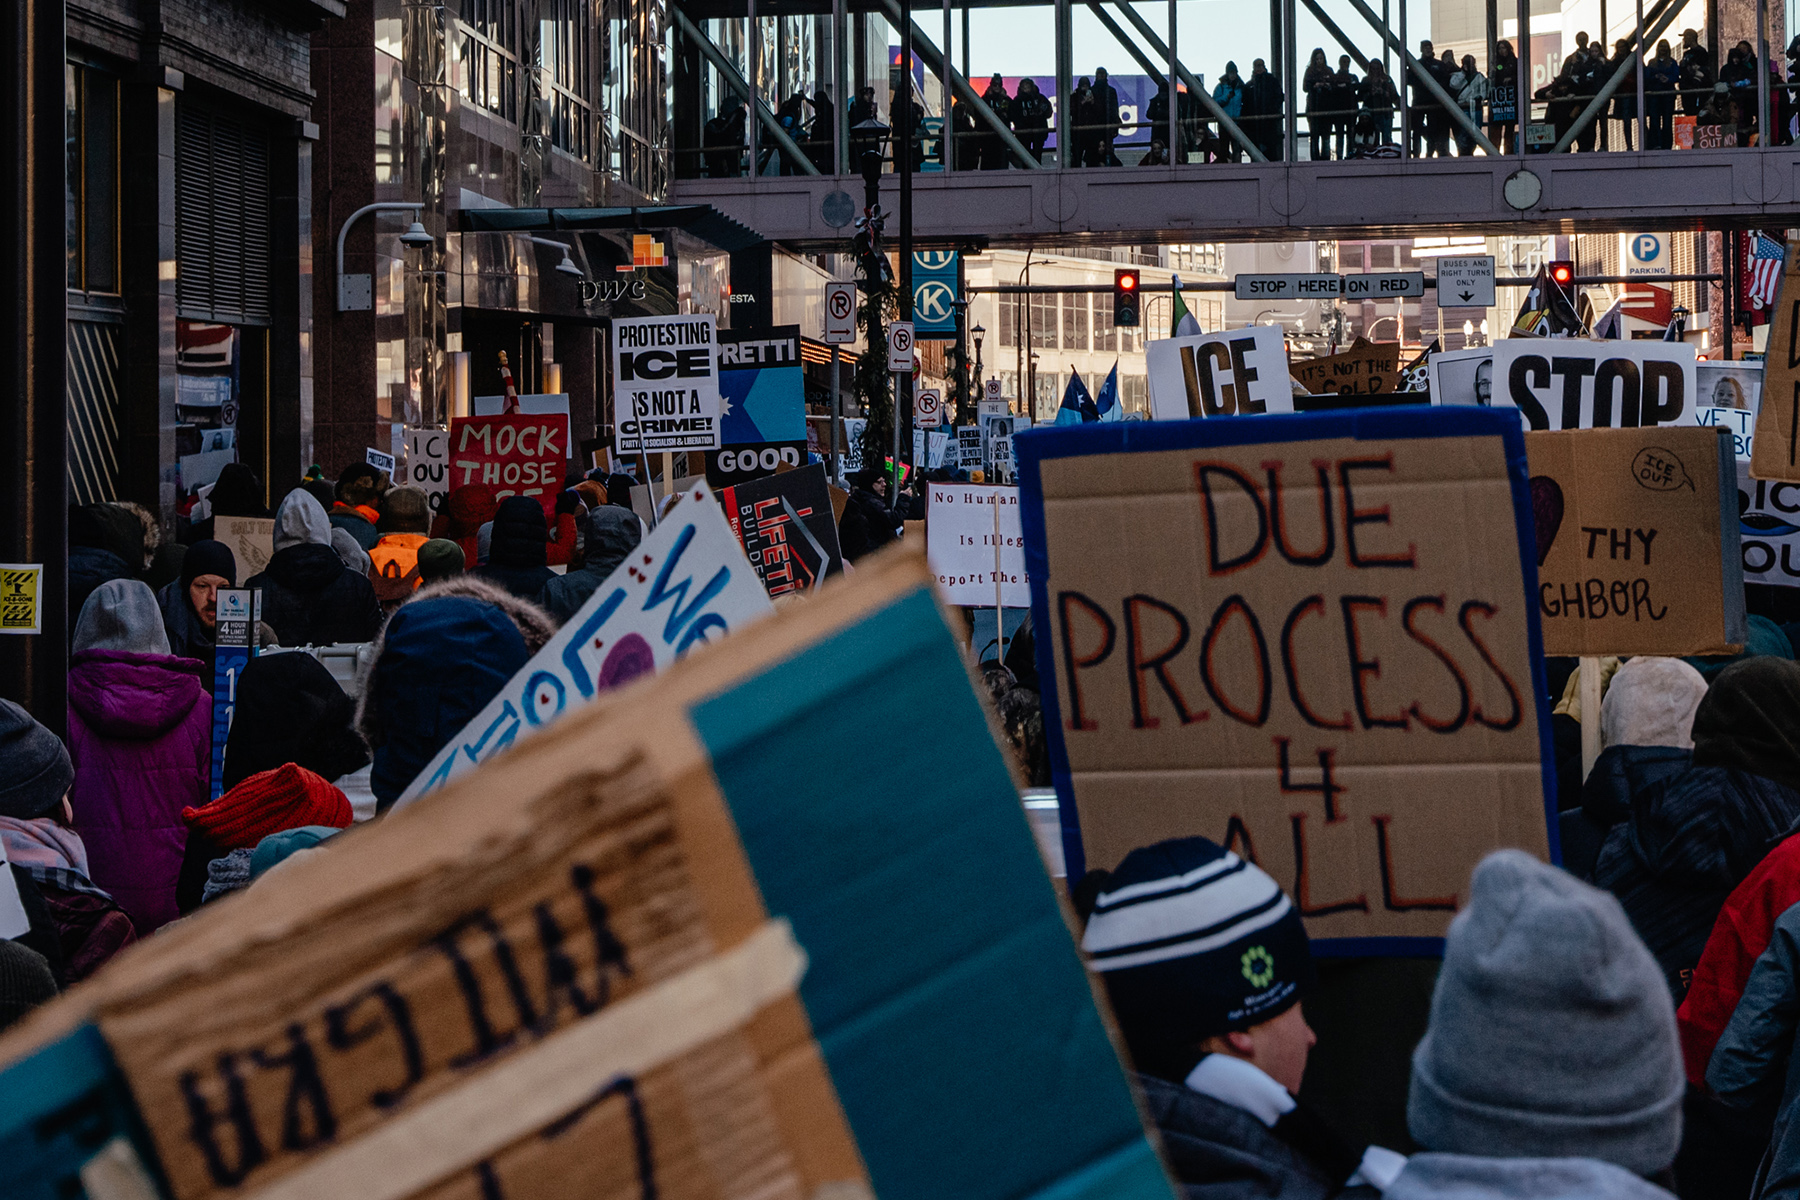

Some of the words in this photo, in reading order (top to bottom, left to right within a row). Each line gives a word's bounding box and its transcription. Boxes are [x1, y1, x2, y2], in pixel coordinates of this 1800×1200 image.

[1491, 86, 1515, 103] ICE
[1697, 125, 1722, 139] ICE
[1700, 138, 1722, 148] OUT
[1444, 259, 1468, 267] BUSES
[1473, 259, 1488, 267] AND
[1629, 267, 1666, 275] PARKING
[1441, 269, 1466, 277] RIGHT
[1469, 269, 1491, 277] TURNS
[577, 279, 645, 308] pwc
[1250, 281, 1286, 292] STOP
[1298, 280, 1337, 292] HERE
[1348, 280, 1369, 292] ON
[1380, 279, 1409, 291] RED
[619, 321, 711, 347] PROTESTING
[620, 349, 711, 381] ICE
[1301, 366, 1326, 381] IT'S
[1333, 360, 1360, 376] NOT
[1366, 359, 1391, 373] THE
[1180, 336, 1267, 417] ICE
[1508, 354, 1684, 430] STOP
[632, 391, 649, 417] IS
[652, 390, 686, 417] NOT
[690, 389, 701, 414] A
[620, 417, 713, 435] CRIME!
[960, 430, 981, 438] GENERAL
[414, 437, 449, 458] IC
[459, 424, 560, 457] MOCK
[622, 439, 639, 448] PARTY
[648, 437, 676, 447] SOCIALISM
[676, 437, 684, 446] &
[684, 435, 713, 446] LIBERATION
[960, 439, 981, 448] STRIKE
[717, 447, 799, 472] GOOD
[960, 458, 982, 467] JUSTICE
[1644, 454, 1675, 475] ICE
[456, 460, 557, 485] THOSE
[1640, 469, 1672, 486] OUT
[935, 492, 954, 503] No
[964, 492, 1017, 504] Human
[1193, 451, 1420, 578] DUE
[754, 497, 813, 600] LIFETI
[960, 535, 973, 545] Is
[983, 535, 1024, 547] Illeg
[1581, 527, 1658, 565] THY
[932, 573, 983, 587] eport
[990, 571, 1017, 584] The
[220, 622, 229, 634] 4
[1056, 590, 1524, 735] PROCESS
[1273, 735, 1348, 824] 4
